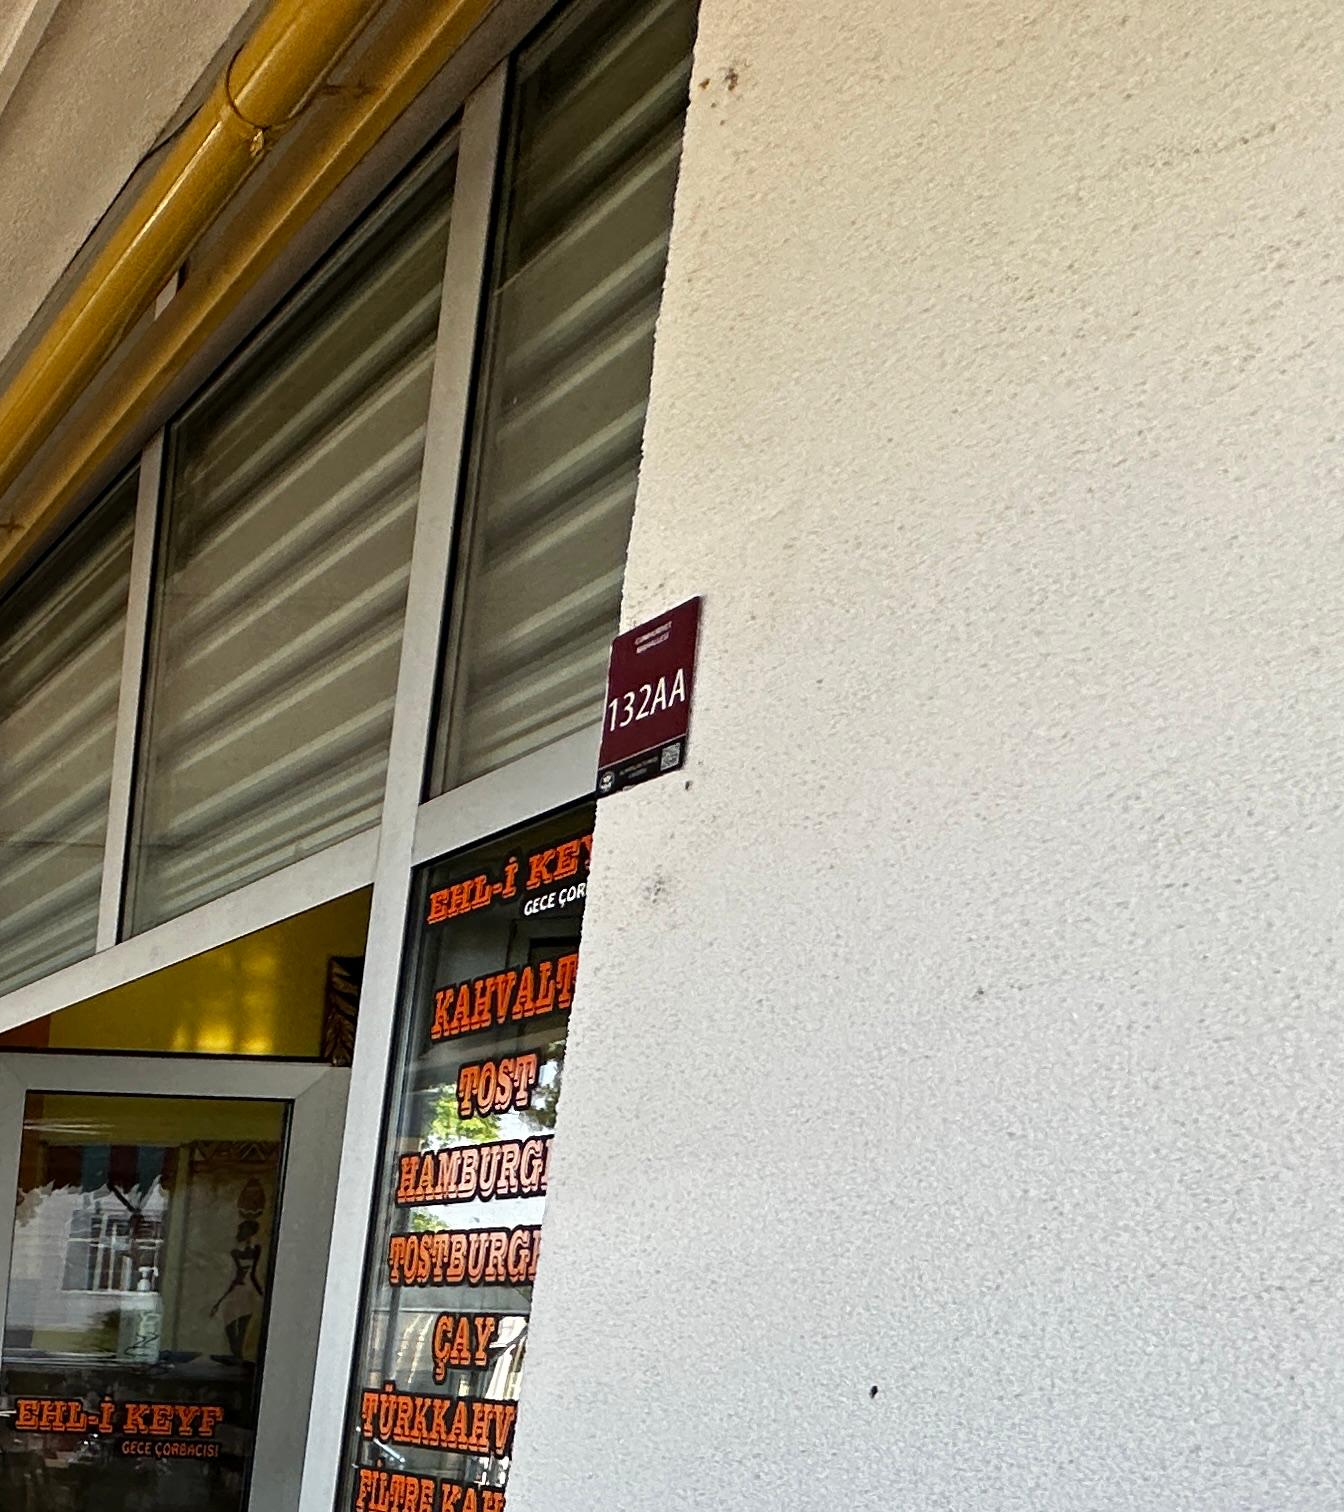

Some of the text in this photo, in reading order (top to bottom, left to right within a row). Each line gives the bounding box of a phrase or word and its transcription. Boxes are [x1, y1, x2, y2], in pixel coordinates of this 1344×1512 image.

[609, 668, 685, 731] 132AA
[427, 856, 518, 924] EHL-İ
[523, 892, 556, 916] GECE
[458, 1053, 538, 1116] TOST
[433, 1315, 495, 1381] ÇAY
[16, 1395, 224, 1436] EHL-İ KEYF
[122, 1441, 219, 1458] GECE ÇORBACISI
